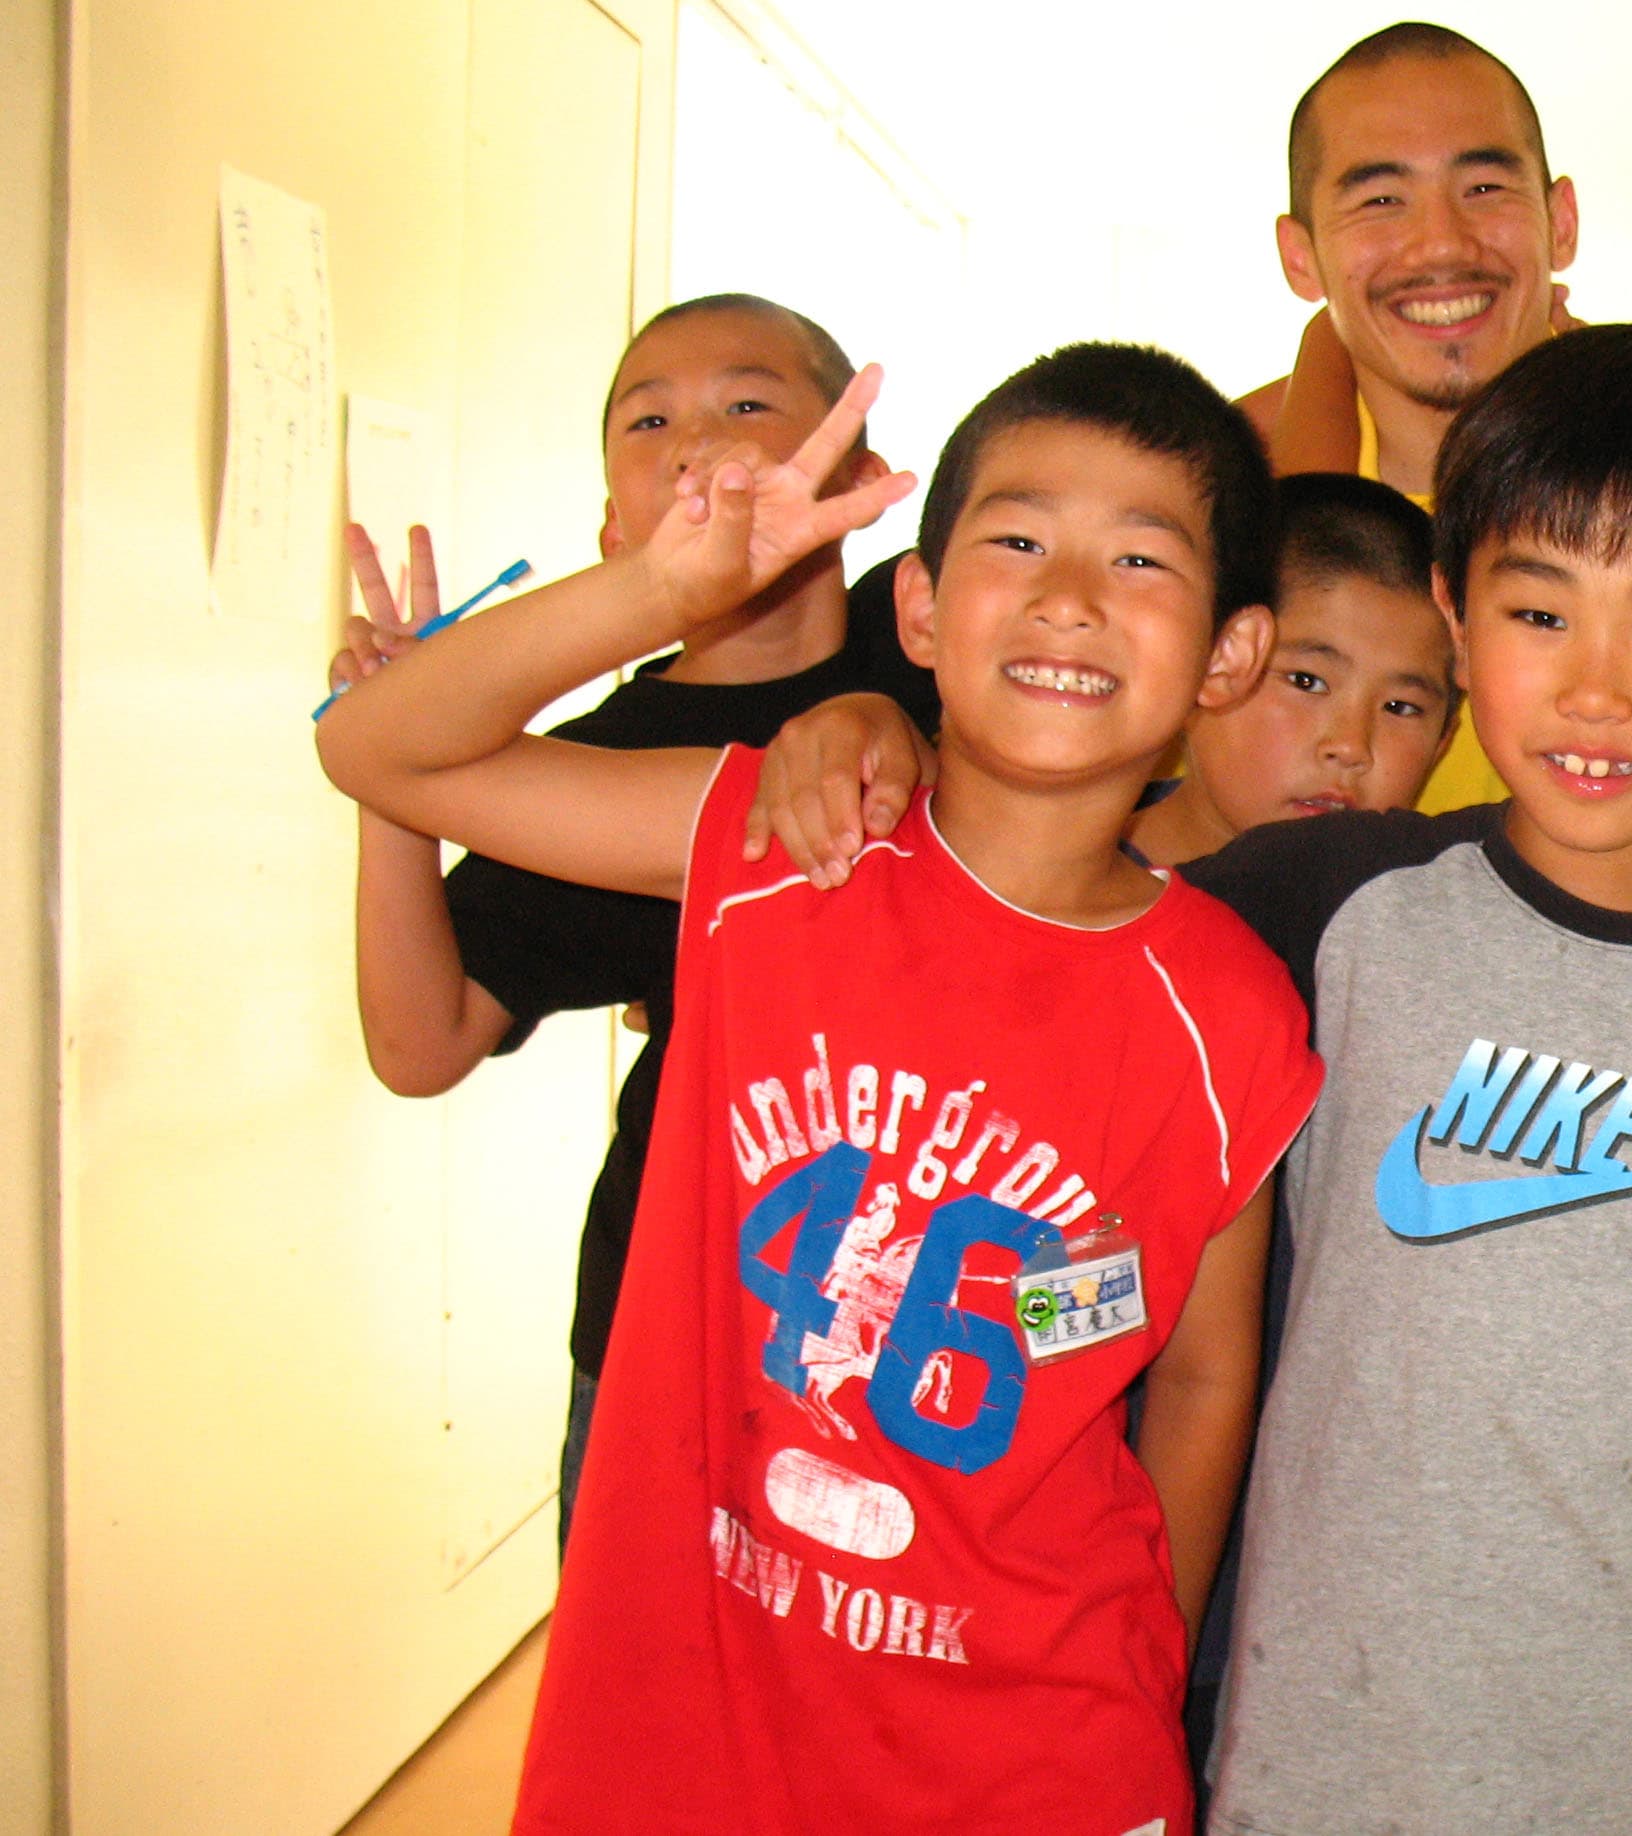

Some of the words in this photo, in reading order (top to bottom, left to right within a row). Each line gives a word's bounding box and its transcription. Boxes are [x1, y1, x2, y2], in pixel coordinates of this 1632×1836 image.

[730, 1032, 1098, 1230] undergrou
[738, 1140, 1068, 1476] 46
[709, 1505, 803, 1618] NEW
[816, 1570, 975, 1665] YORK
